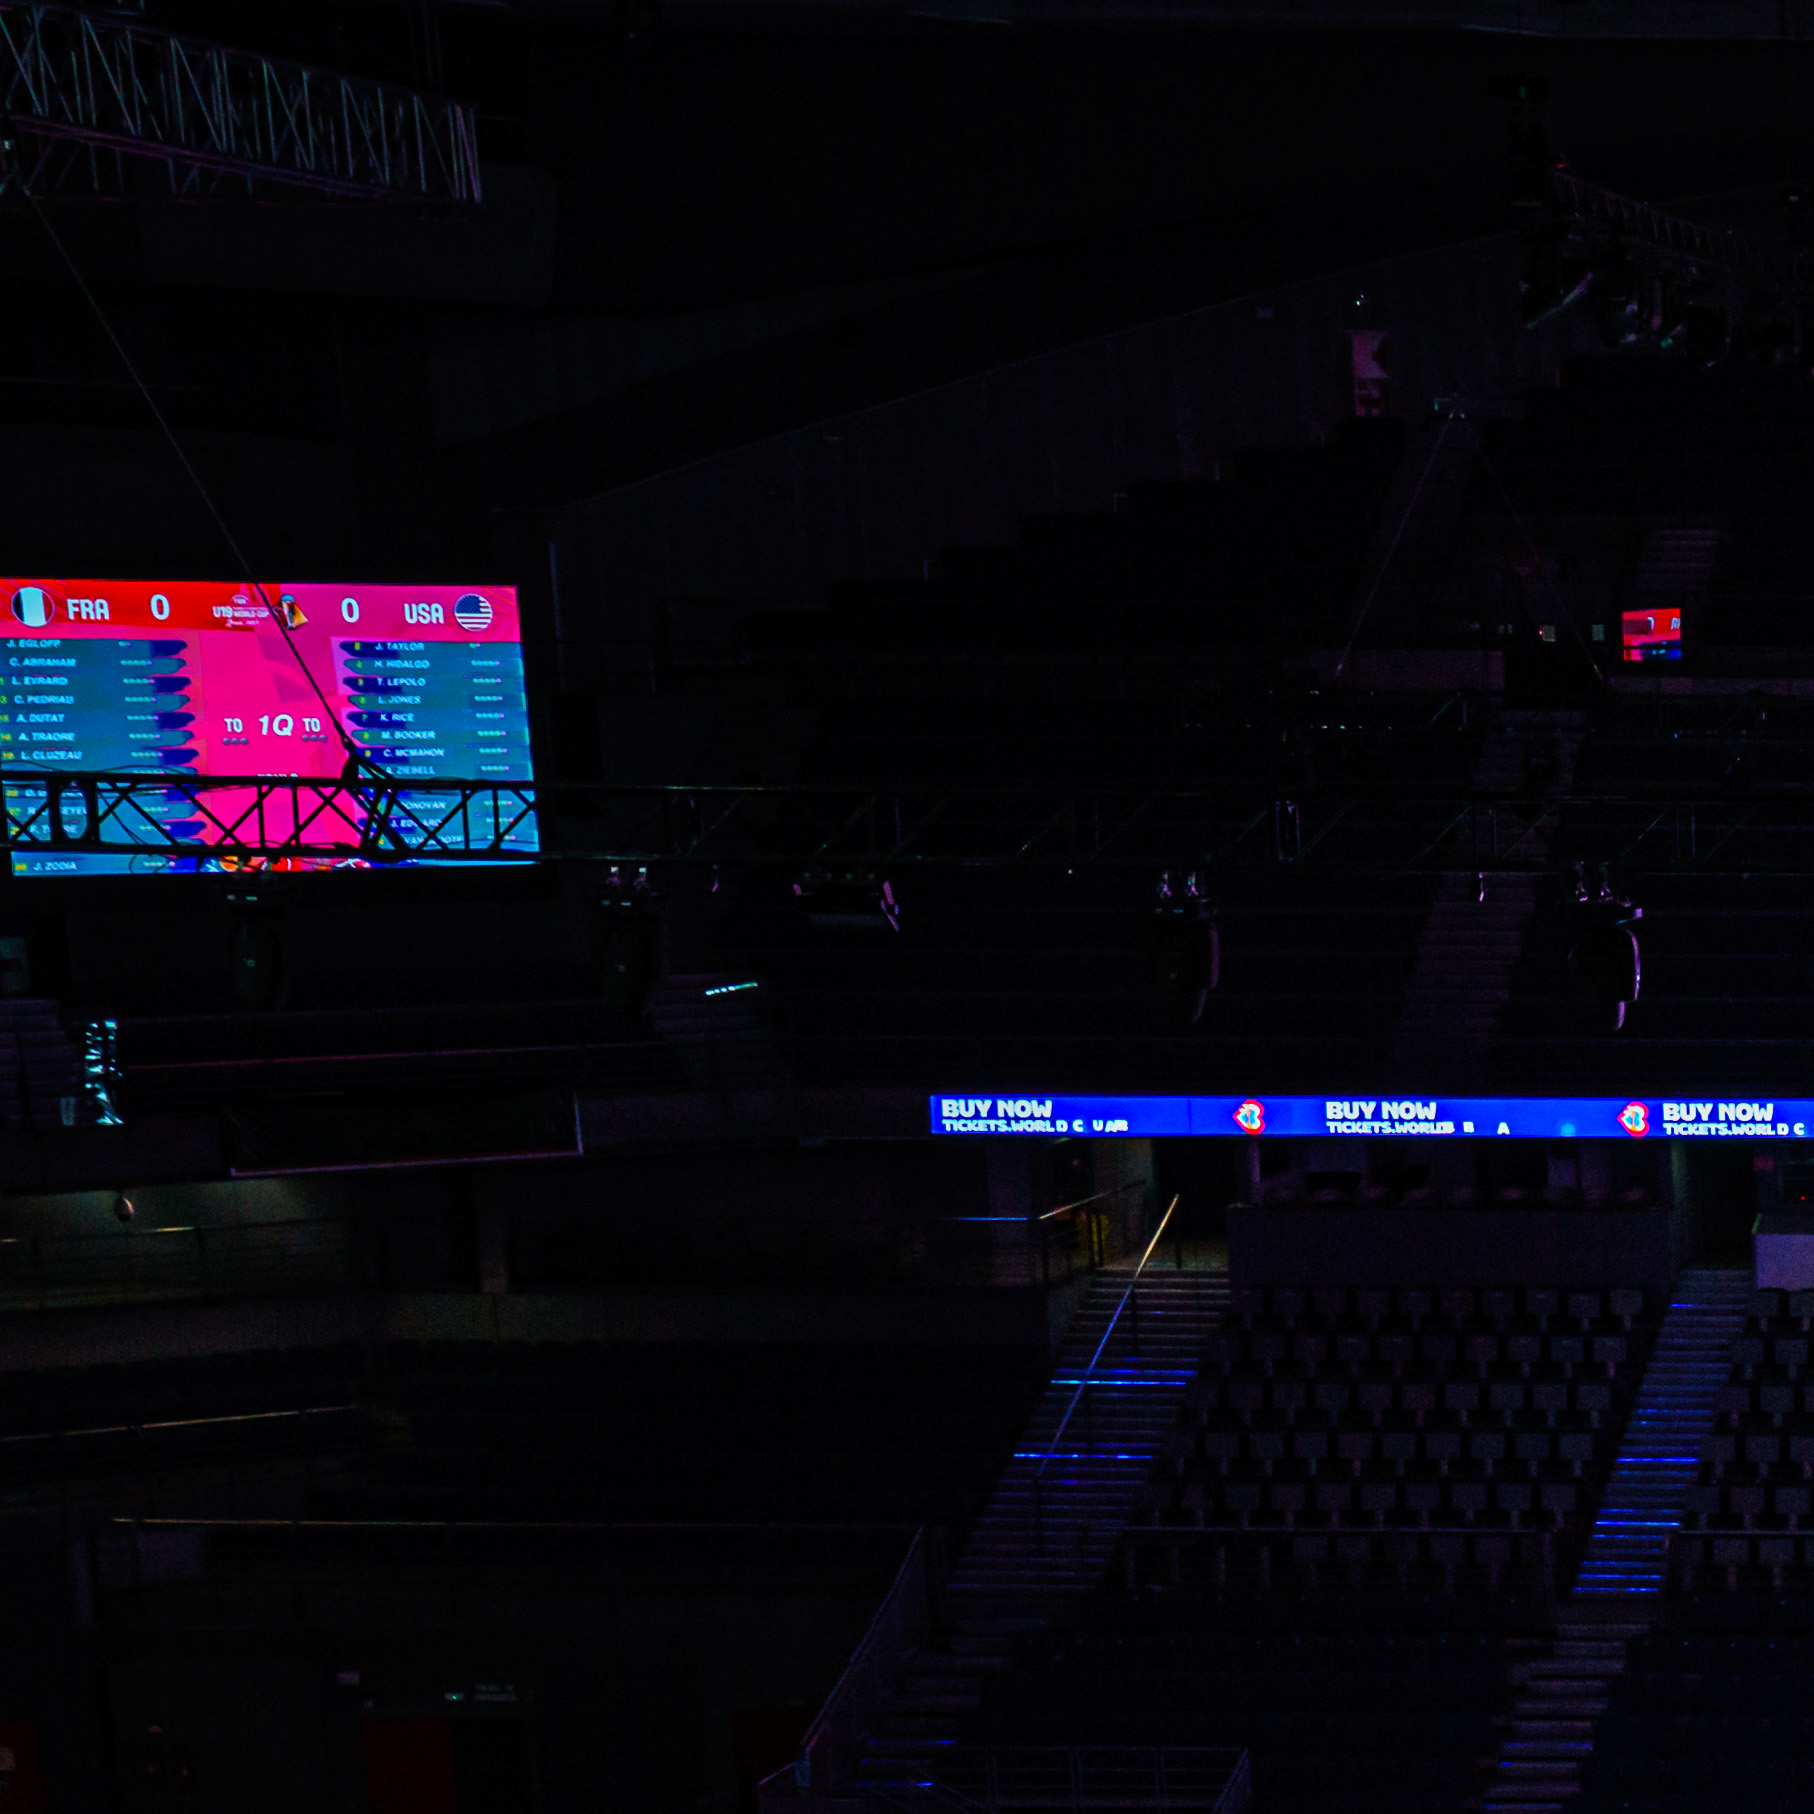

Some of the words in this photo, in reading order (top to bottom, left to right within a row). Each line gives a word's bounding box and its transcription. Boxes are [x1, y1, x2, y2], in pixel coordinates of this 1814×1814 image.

[67, 599, 110, 621] FRA
[151, 594, 170, 620] 0
[213, 606, 232, 618] U19
[341, 598, 359, 622] 0
[404, 603, 444, 624] USA
[224, 718, 242, 733] TO
[259, 714, 294, 736] 1Q
[302, 718, 321, 732] TO
[941, 1099, 992, 1118] BUY
[997, 1099, 1052, 1118] NOW
[1325, 1101, 1376, 1120] BUY
[1382, 1101, 1437, 1120] NOW
[1662, 1103, 1714, 1122] BUY
[1718, 1103, 1774, 1122] NOW
